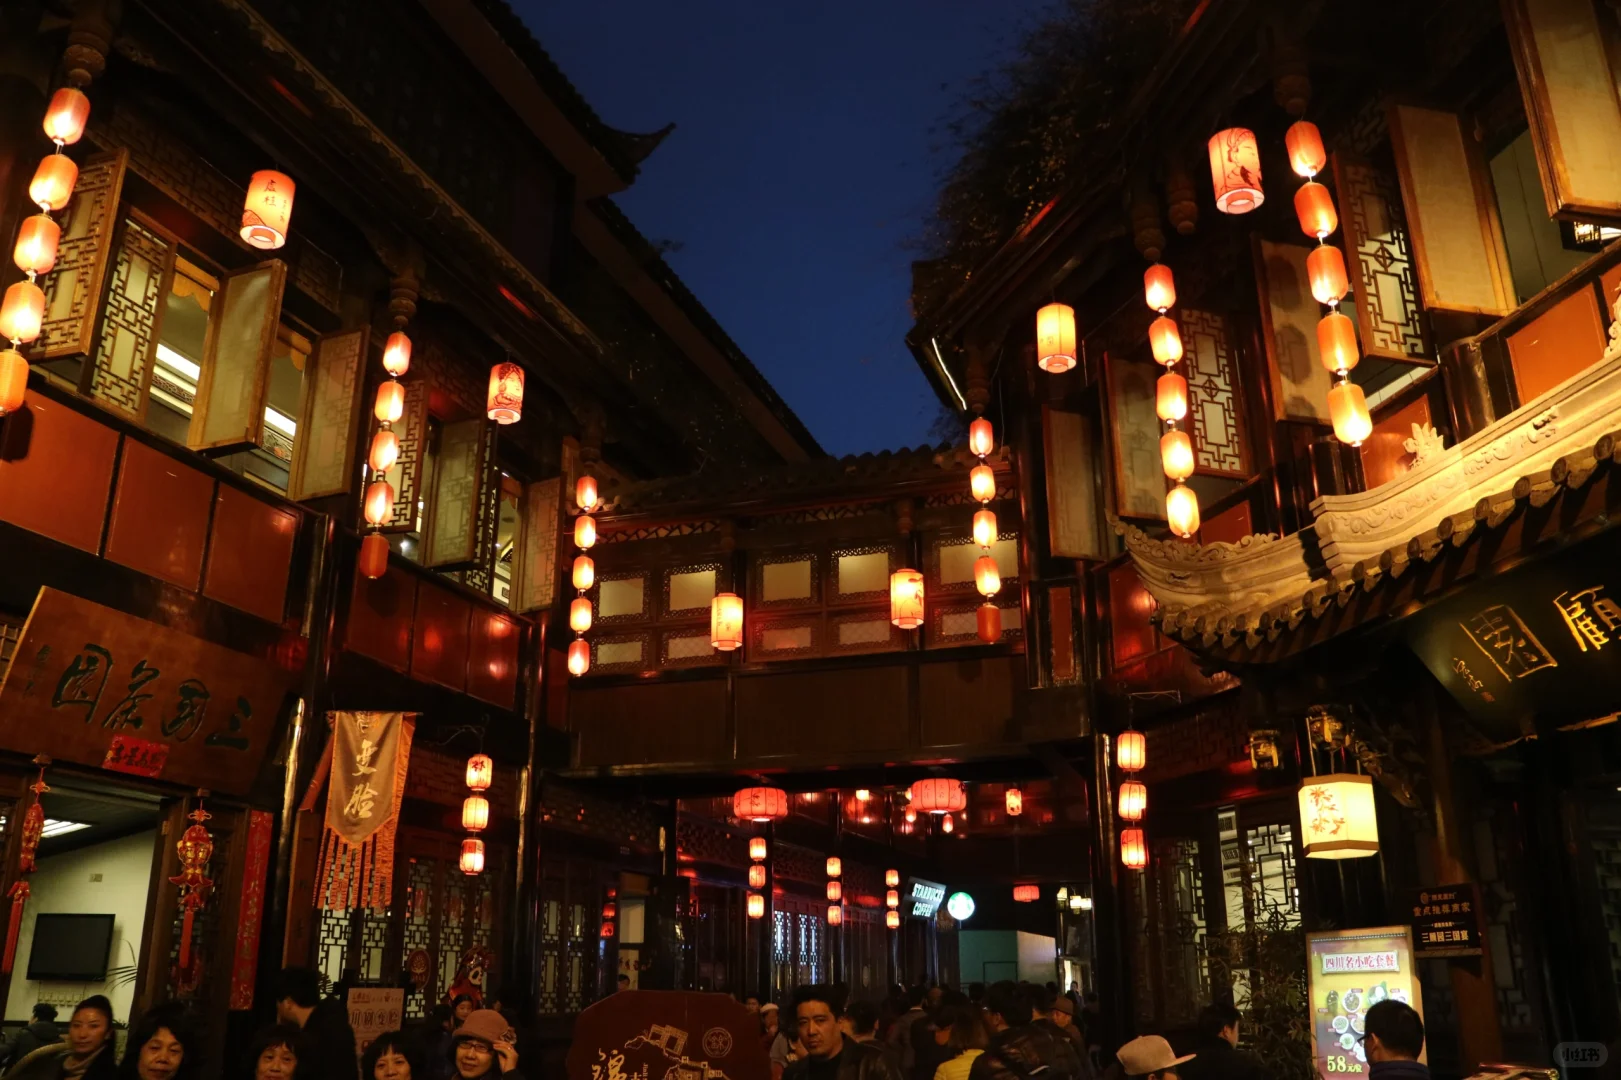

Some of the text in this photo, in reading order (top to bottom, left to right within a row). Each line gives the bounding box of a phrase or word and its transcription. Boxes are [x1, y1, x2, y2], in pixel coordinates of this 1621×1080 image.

[912, 902, 933, 918] COFFEE
[1325, 953, 1395, 969] 四川名小吃套餐
